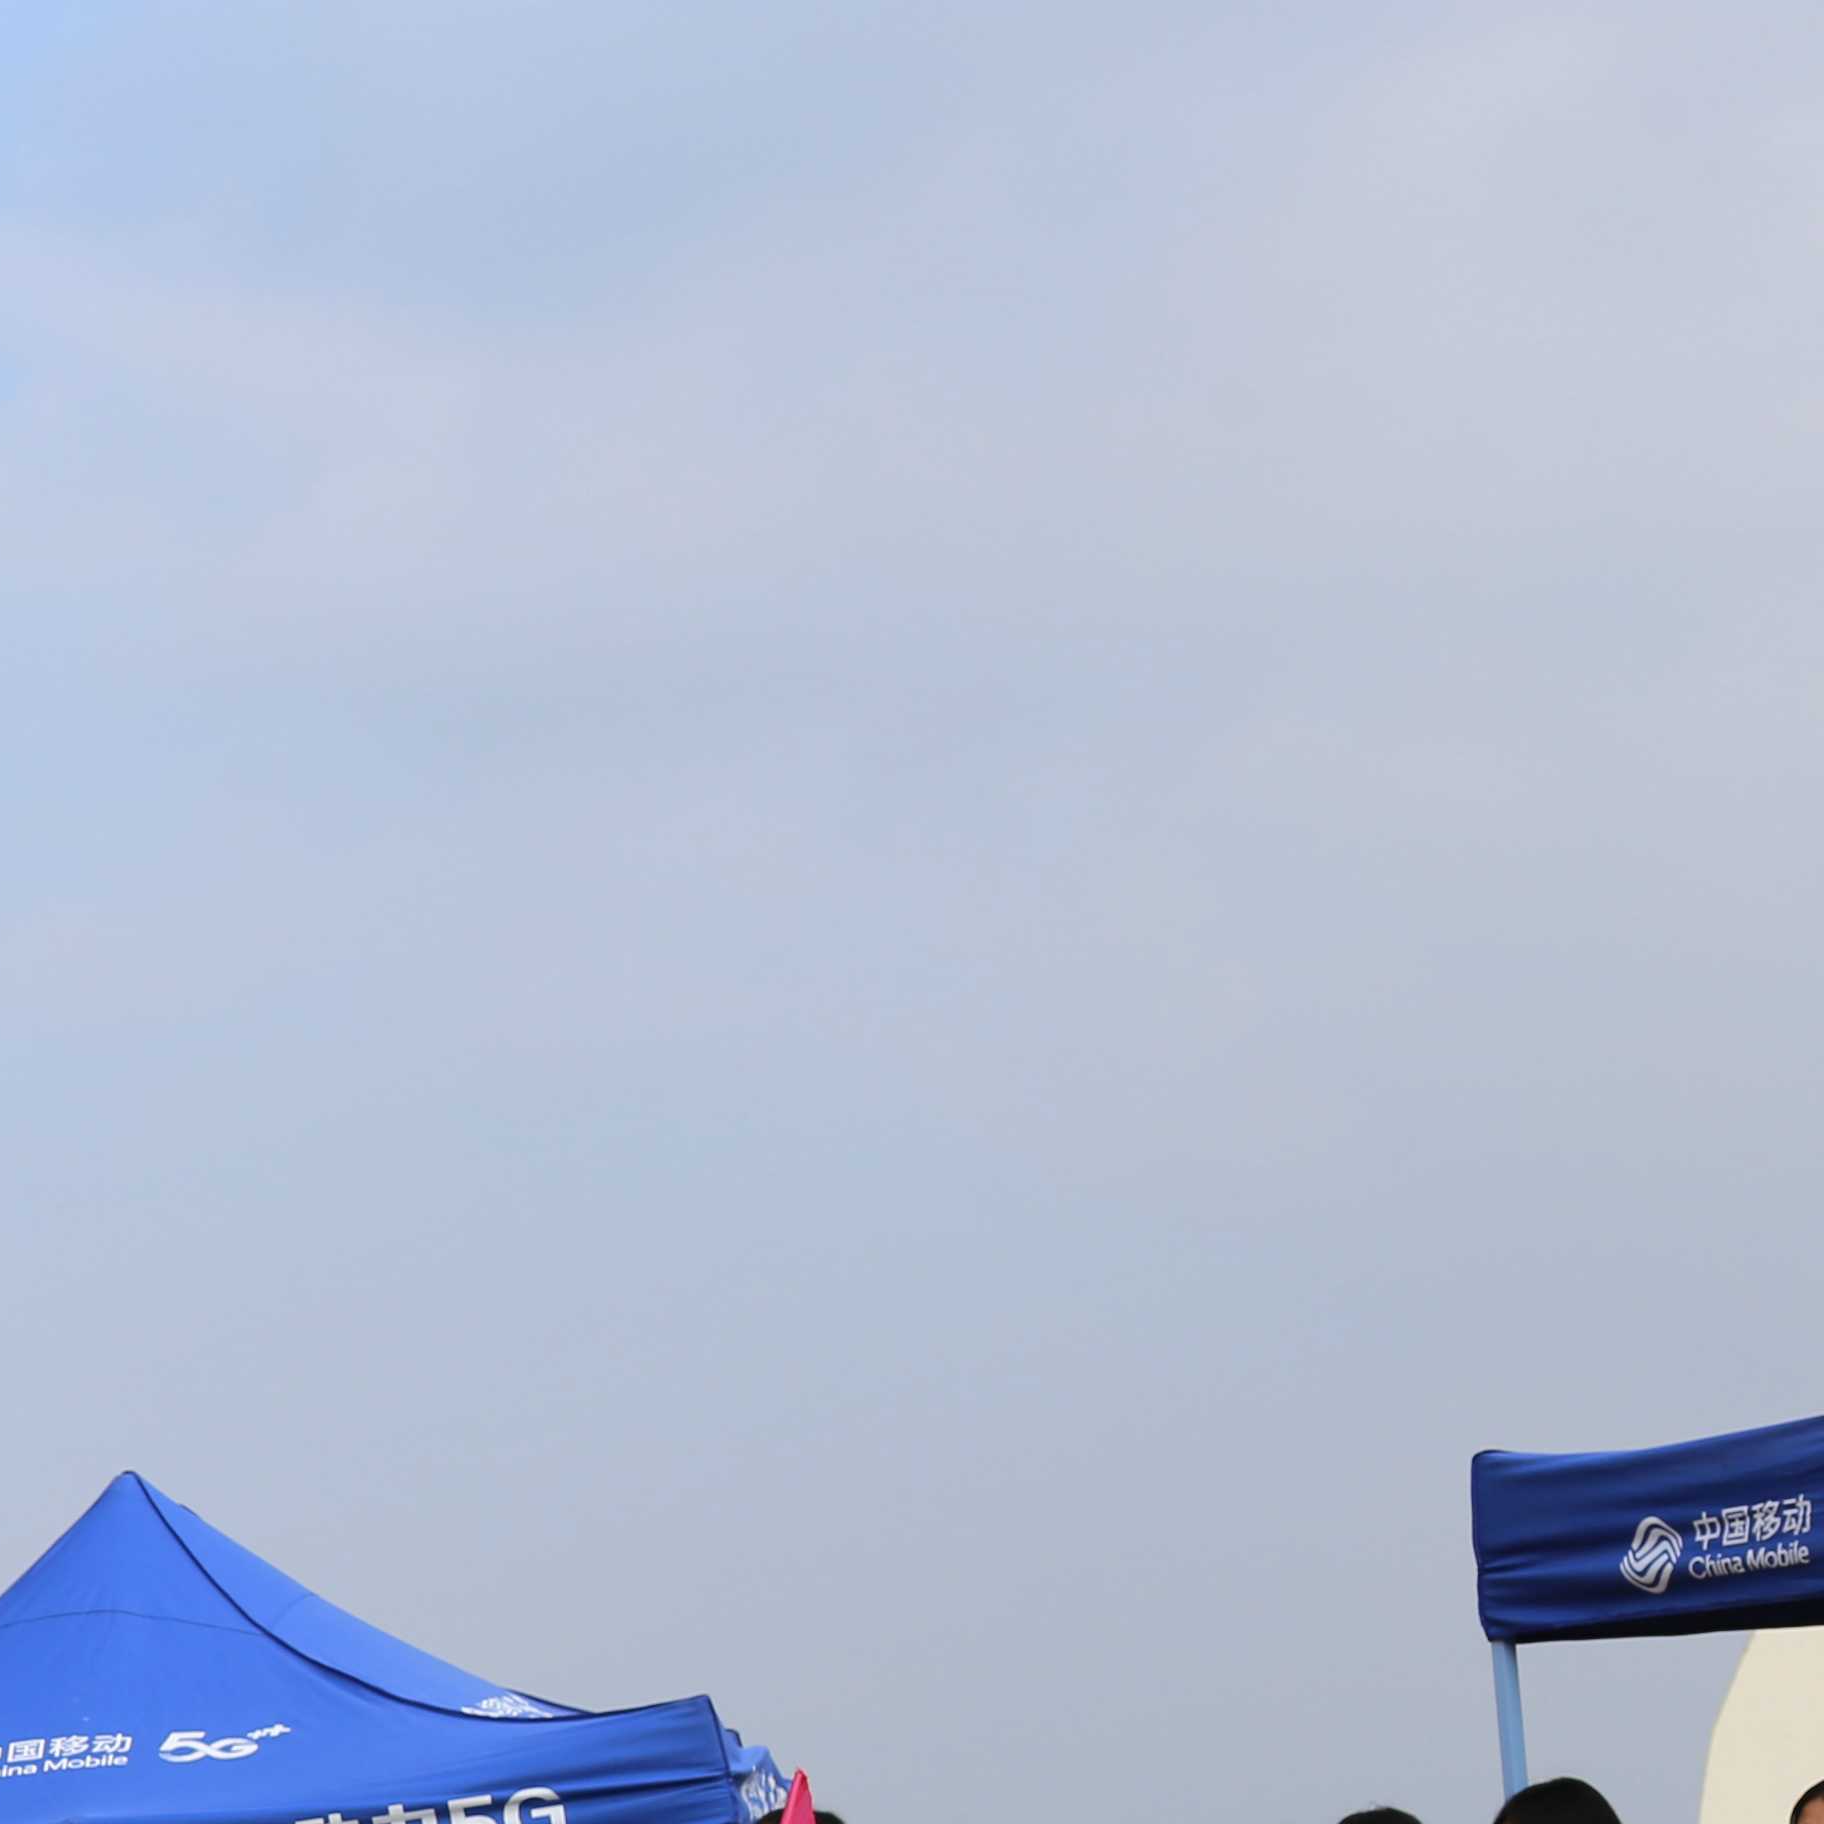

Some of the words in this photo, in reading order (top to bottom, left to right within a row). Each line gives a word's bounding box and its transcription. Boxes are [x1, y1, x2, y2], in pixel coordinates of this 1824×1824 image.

[1693, 1494, 1812, 1550] 中国移动
[1688, 1551, 1745, 1580] China
[1747, 1541, 1809, 1570] Mobile
[43, 1753, 128, 1773] Mobile
